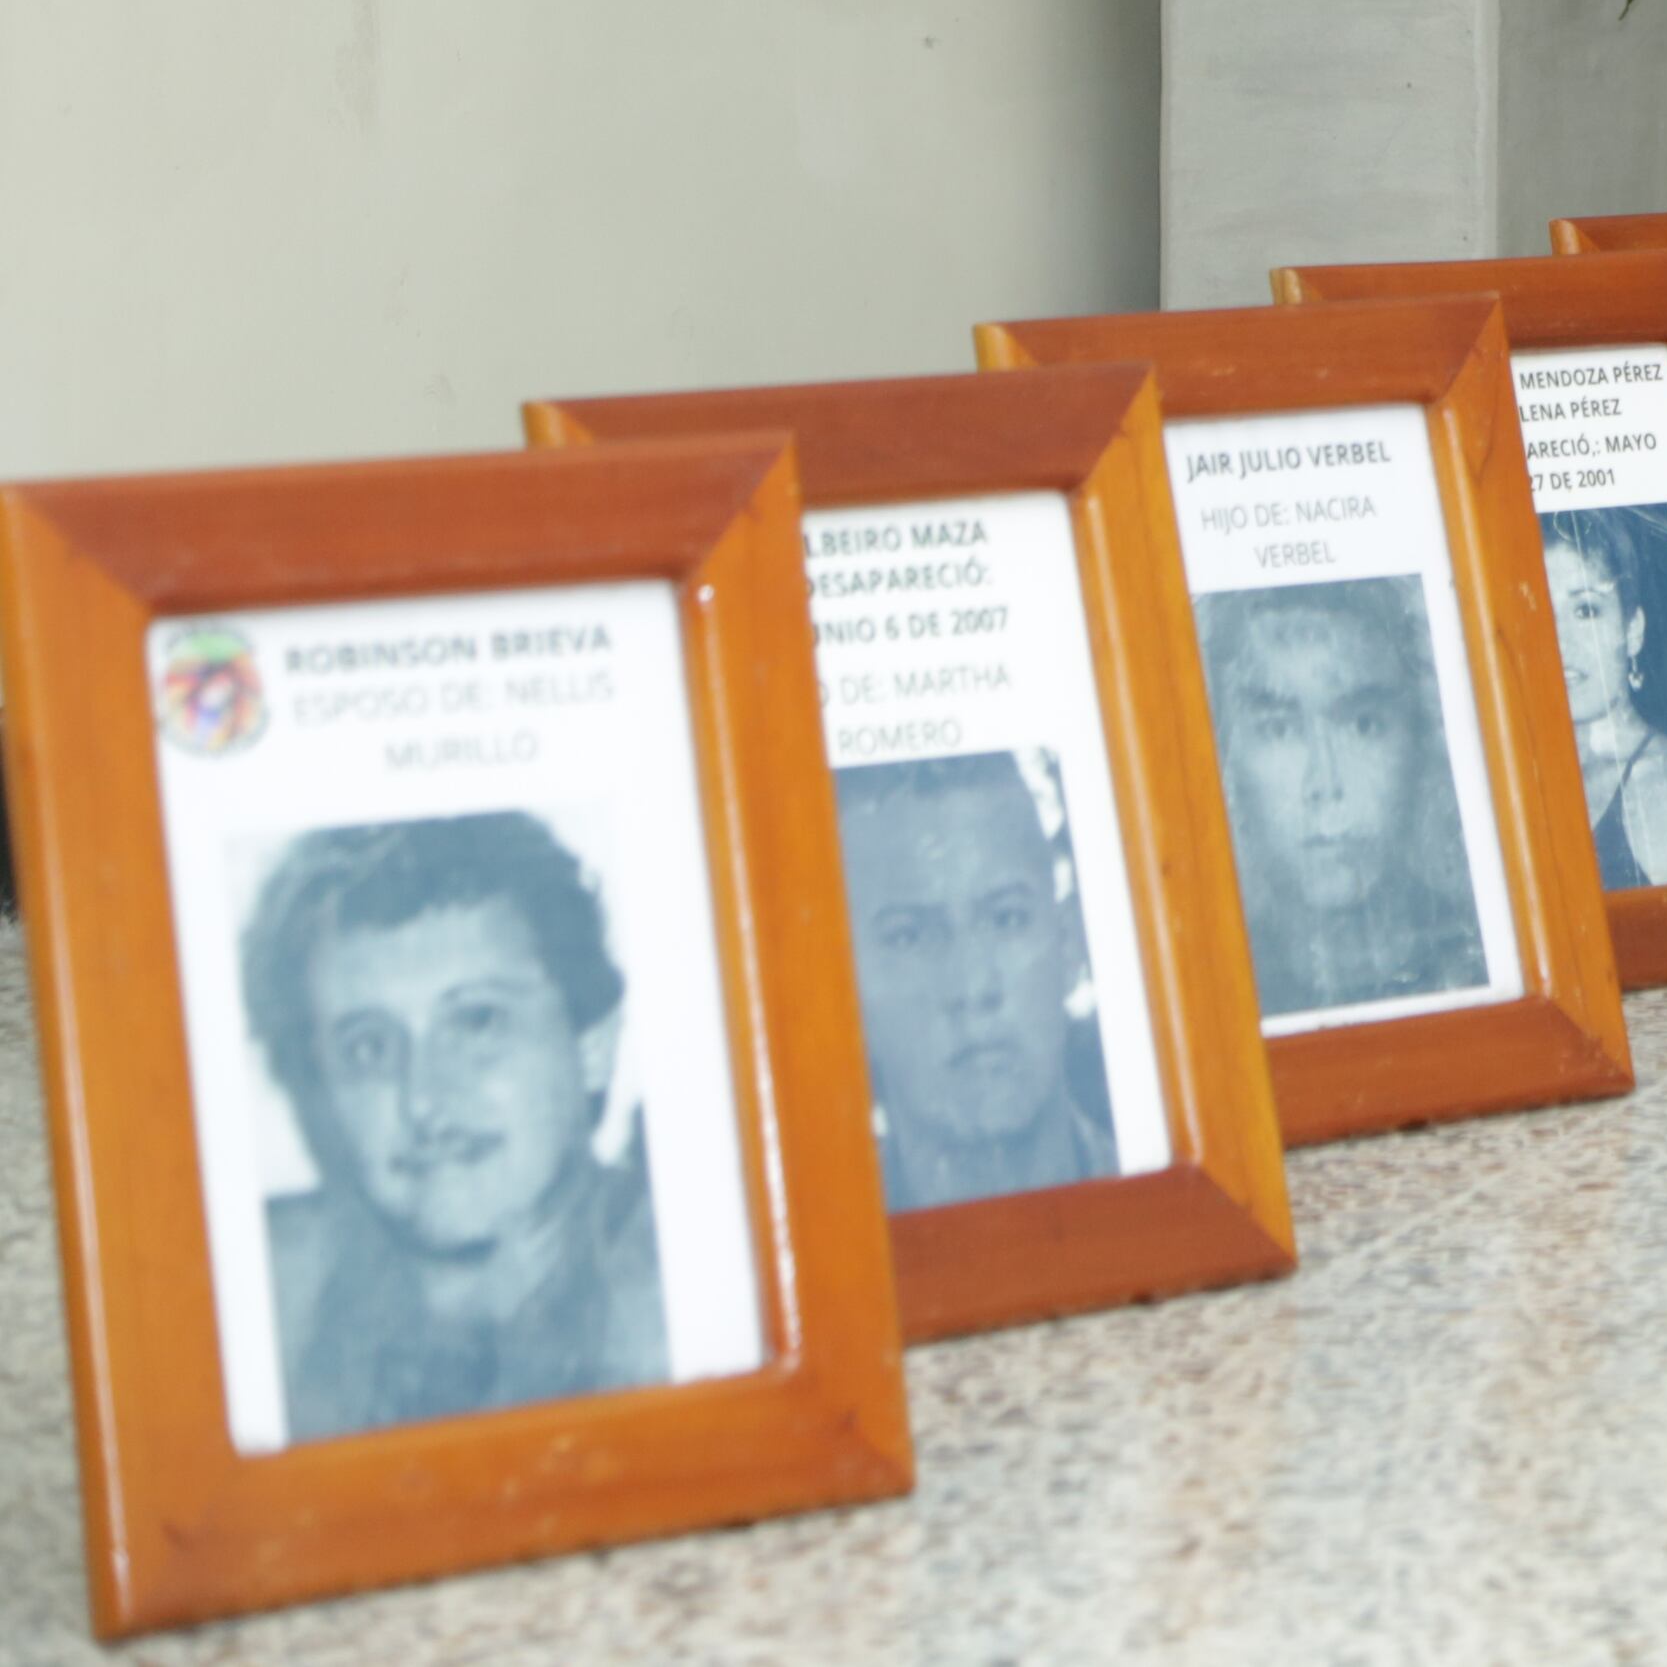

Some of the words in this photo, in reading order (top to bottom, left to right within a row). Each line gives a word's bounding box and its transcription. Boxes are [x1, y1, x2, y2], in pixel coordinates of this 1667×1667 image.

[1519, 366, 1609, 391] MENDOZA
[1612, 360, 1664, 383] PÉREZ
[1519, 402, 1567, 423] LENA
[1570, 396, 1623, 419] PÉREZ
[1605, 432, 1657, 454] MAYO
[1186, 452, 1232, 483] JAIR
[1239, 446, 1301, 479] JULIO
[1307, 440, 1392, 469] VERBEL
[1578, 468, 1616, 488] 2001
[1201, 504, 1249, 535] HIJO
[1295, 495, 1377, 523] NACIRA
[911, 519, 987, 550] MAZA
[1253, 540, 1337, 570] VERBEL
[907, 611, 941, 638] DE
[951, 604, 1009, 635] 2007
[286, 634, 479, 677] ROBINSON
[492, 623, 613, 662] BRIEVA
[893, 664, 1012, 700] MARTHA
[293, 680, 431, 725] ESPOSO
[384, 729, 539, 772] MURILLO
[836, 717, 962, 756] ROMERO
